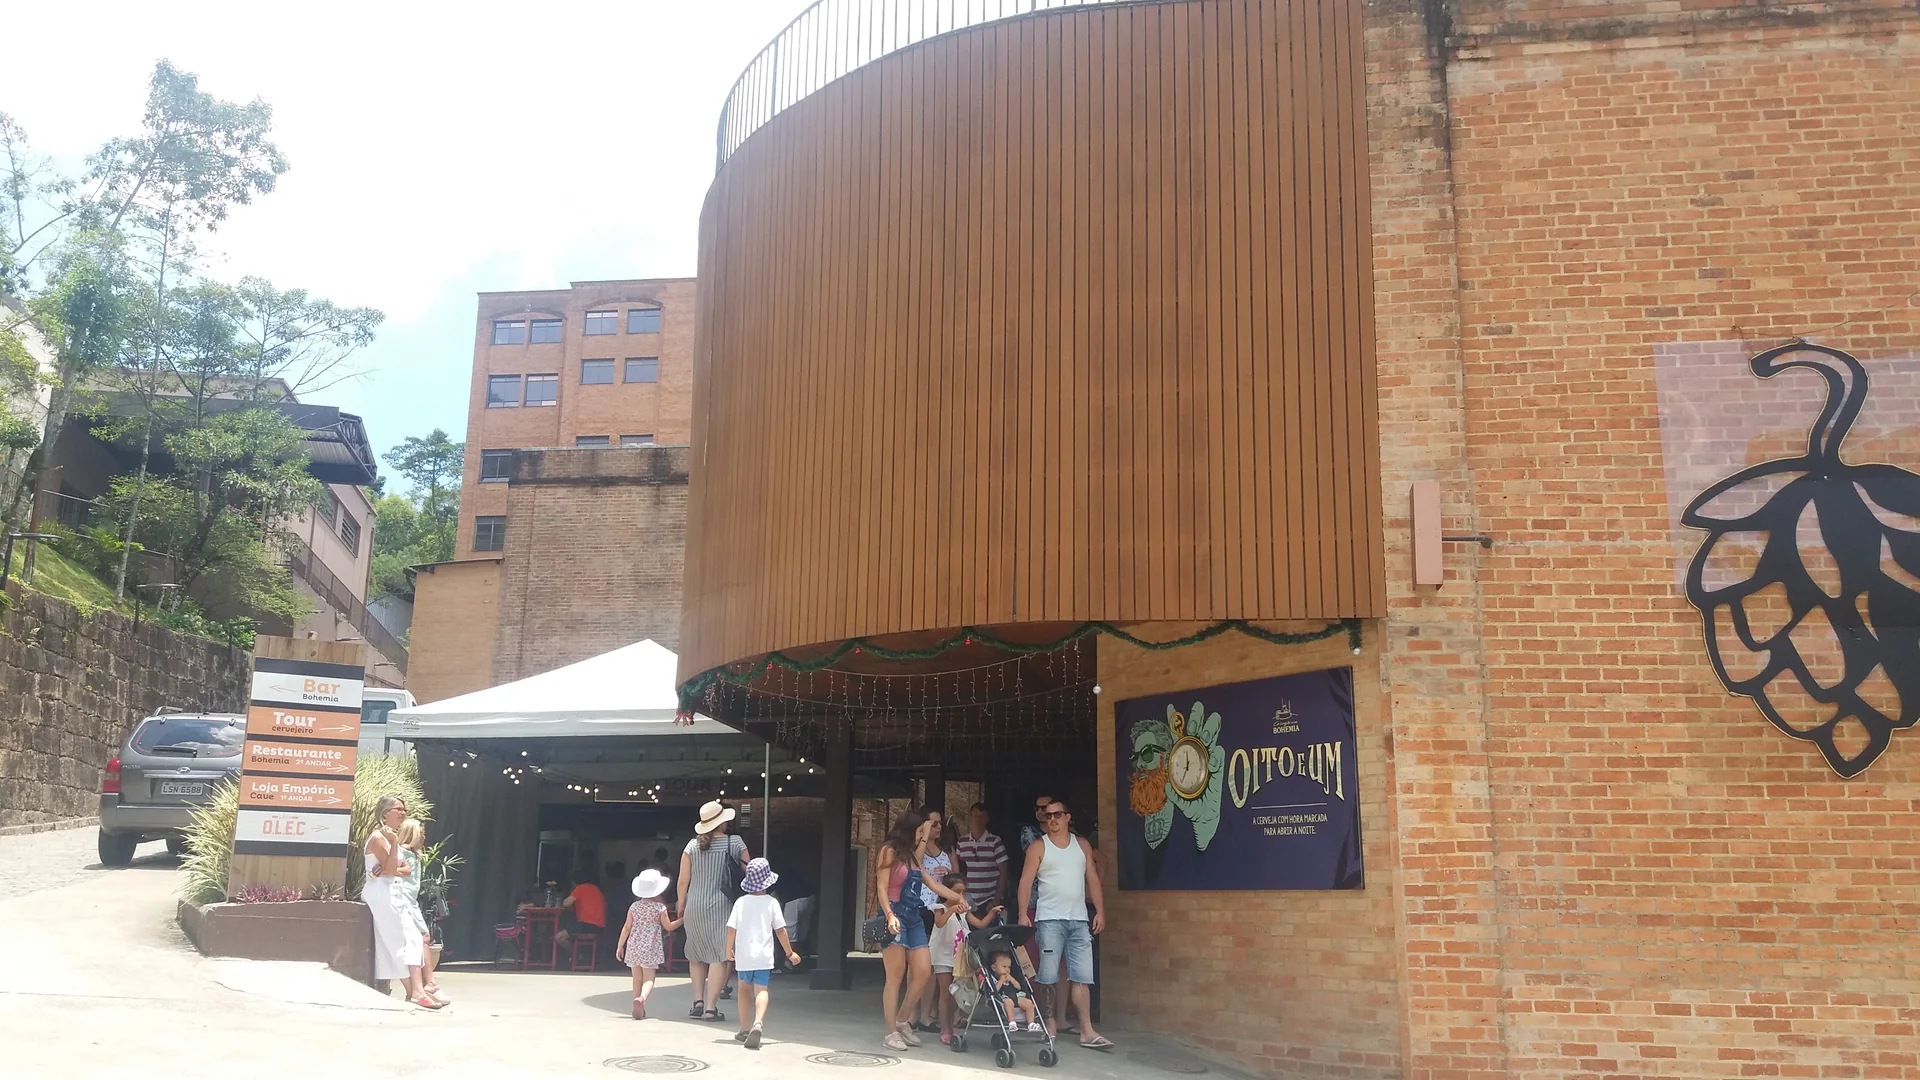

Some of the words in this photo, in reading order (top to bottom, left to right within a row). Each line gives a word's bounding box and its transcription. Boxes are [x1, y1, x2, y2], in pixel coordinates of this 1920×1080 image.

[303, 678, 341, 694] Bar
[302, 693, 339, 702] Bohemia
[273, 711, 316, 727] Tour
[271, 725, 314, 734] cervejeiro
[1272, 725, 1300, 735] BOHEMIA
[252, 744, 342, 759] Restaurante
[251, 755, 290, 764] Bohemia
[1227, 746, 1295, 809] OITO
[1297, 752, 1307, 777] E
[1307, 740, 1345, 801] UM
[251, 782, 279, 794] Loja
[282, 783, 336, 796] Empório
[249, 792, 275, 801] Cave
[1252, 816, 1257, 826] A
[1256, 815, 1278, 826] CERVEJA
[1277, 814, 1290, 825] COM
[1289, 814, 1304, 824] HORA
[1303, 813, 1328, 823] MARCADA
[1263, 827, 1277, 836] PARA
[1277, 826, 1294, 835] ABRIR
[1293, 826, 1298, 835] A
